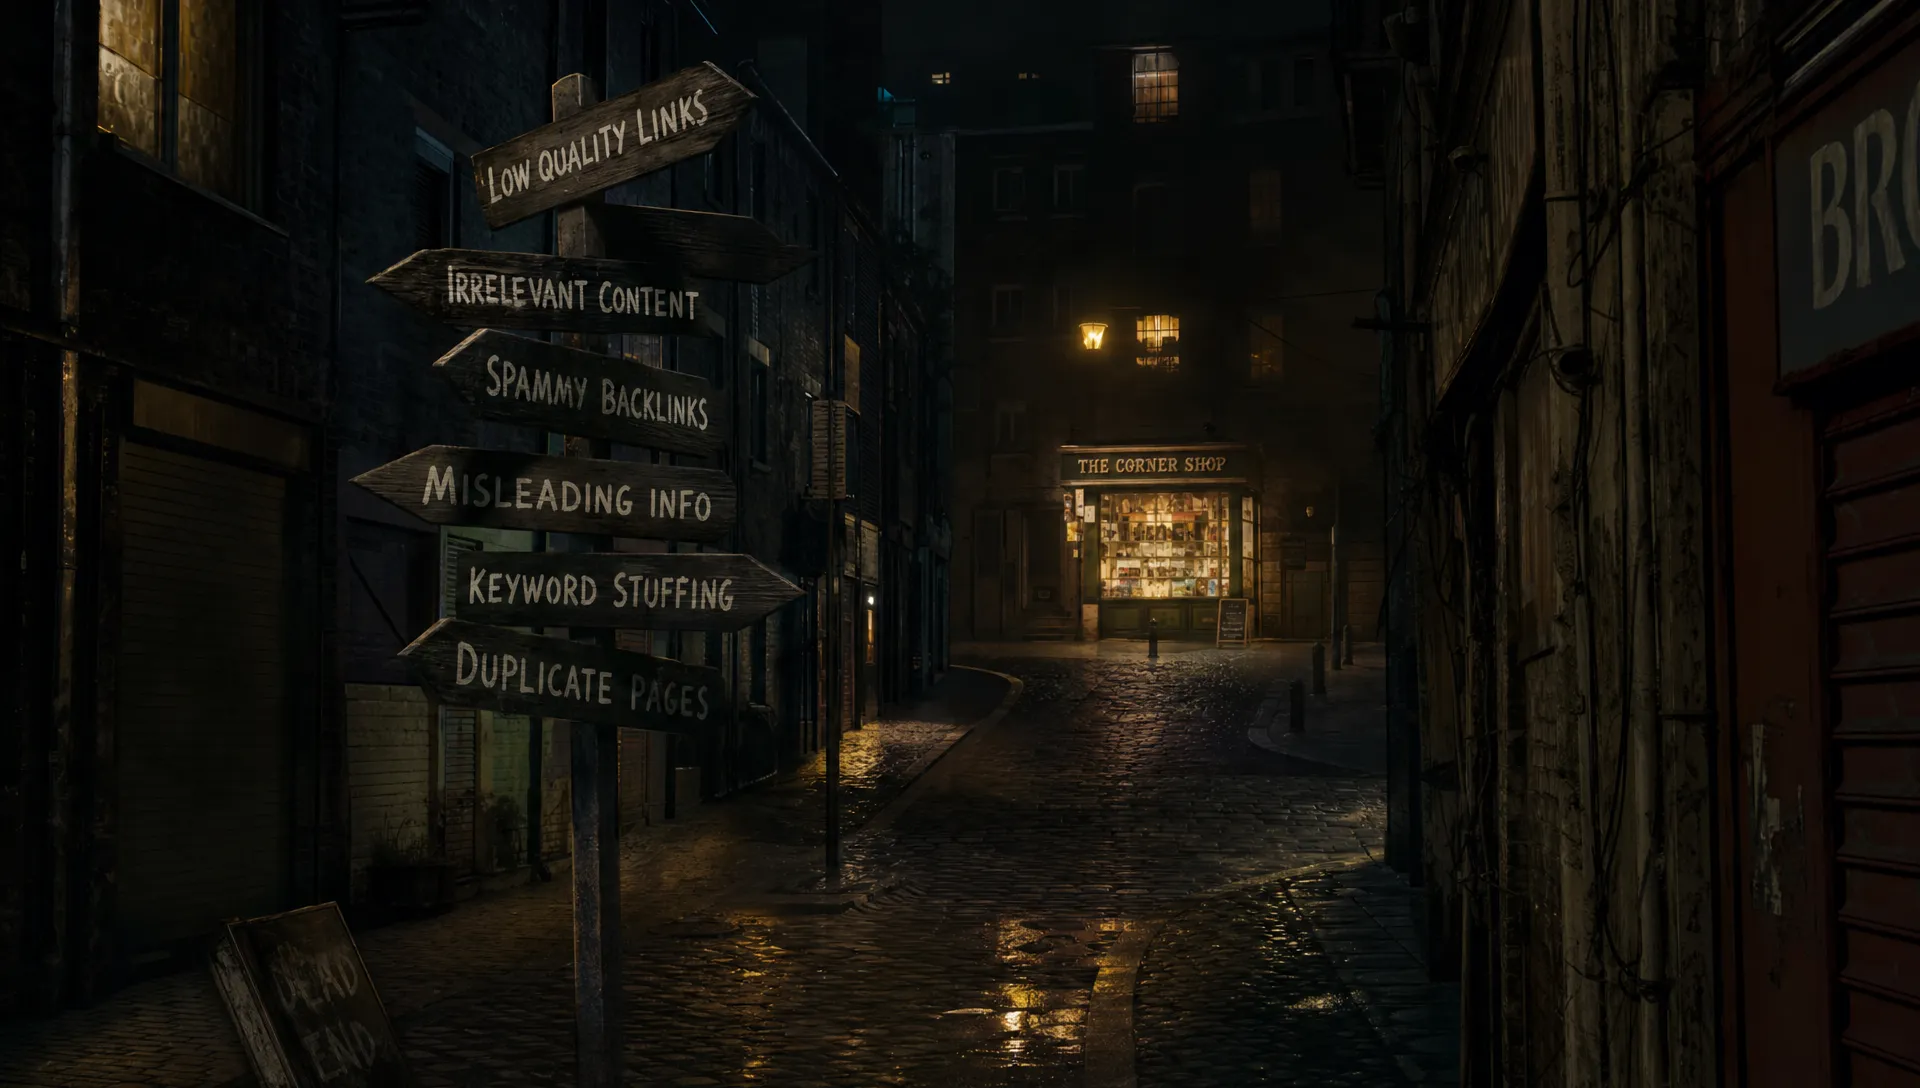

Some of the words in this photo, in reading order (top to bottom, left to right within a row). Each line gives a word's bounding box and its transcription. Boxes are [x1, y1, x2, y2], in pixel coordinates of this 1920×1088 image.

[486, 159, 531, 204] LOW
[537, 119, 627, 181] QUALITY
[636, 88, 709, 146] LINKS
[447, 264, 589, 311] IRRELEVANT
[598, 279, 700, 321] CONTENT
[485, 354, 588, 411] SPAMMY
[601, 377, 709, 431] BACKLINKS
[421, 464, 633, 518] MISLEADING
[649, 488, 712, 522] INFO
[1077, 458, 1109, 474] THE
[1115, 456, 1178, 474] CORNER
[1184, 456, 1227, 473] SHOP
[468, 565, 598, 607] KEYWORD
[612, 570, 735, 612] STUFFING
[455, 640, 613, 705] DUPLICATE
[630, 672, 710, 721] PAGES
[301, 1019, 376, 1082] END
